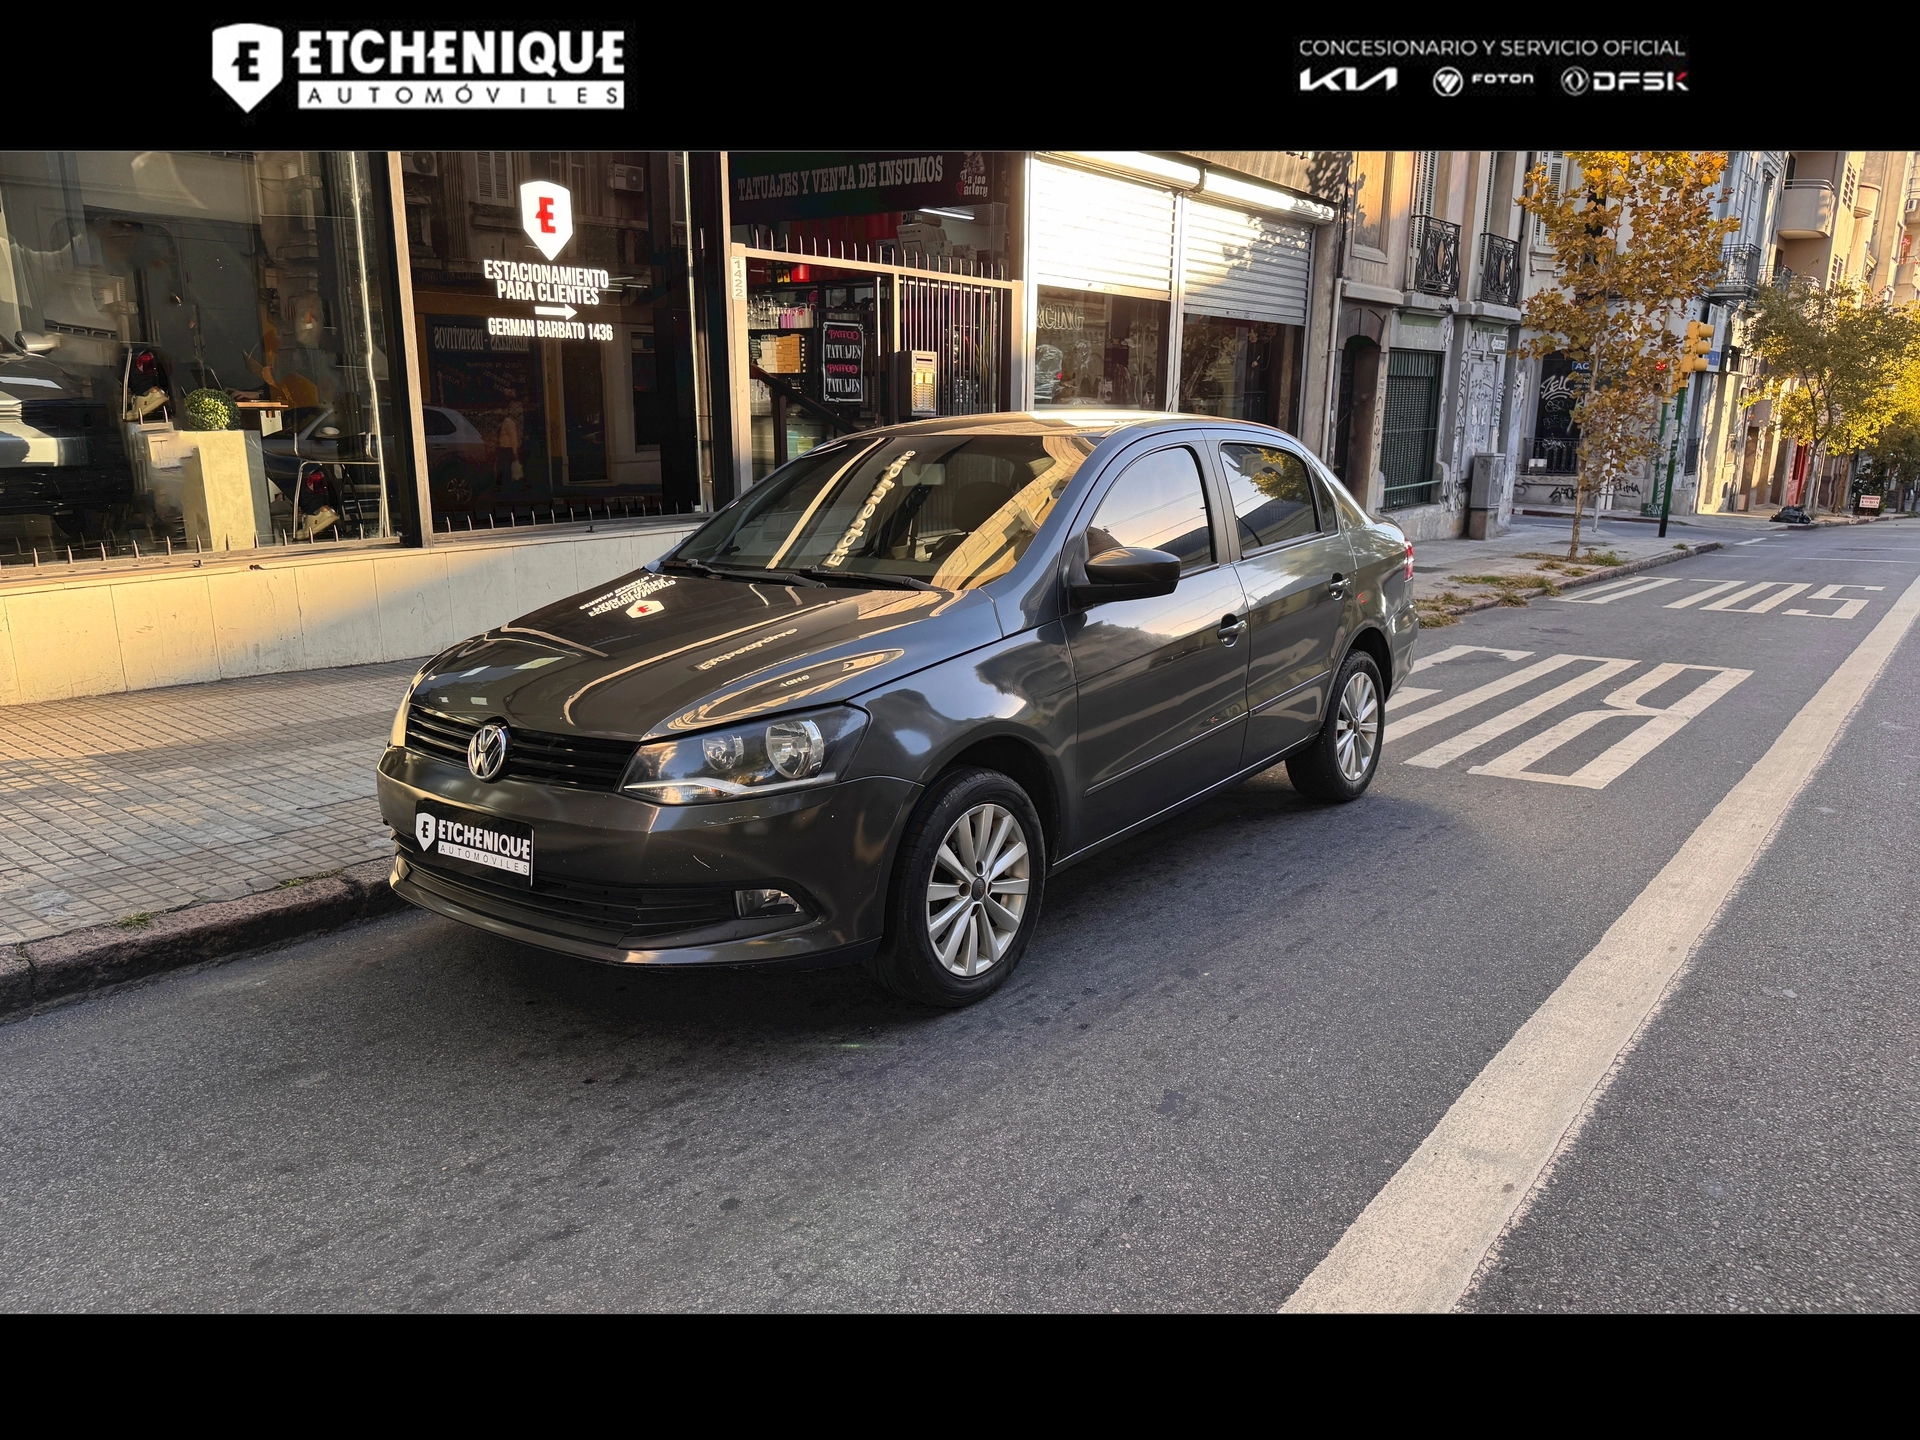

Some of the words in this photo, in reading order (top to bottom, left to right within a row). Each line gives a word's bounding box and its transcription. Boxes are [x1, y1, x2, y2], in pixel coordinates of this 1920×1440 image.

[737, 173, 799, 201] TATUAJES
[800, 170, 810, 195] Y
[812, 167, 856, 192] VENTA
[859, 163, 876, 188] DE
[879, 155, 943, 186] INSUMOS
[483, 259, 609, 288] ESTACIONAMIENTO
[734, 259, 744, 298] 1422
[497, 280, 535, 301] PARA
[537, 283, 600, 306] CLIENTES
[488, 317, 535, 337] GERMAN
[537, 320, 585, 340] BARBATO
[587, 322, 613, 341] 1436
[826, 344, 861, 359] TATUAJES
[826, 378, 860, 393] TATUAJES
[438, 819, 531, 860] ETCHENIQUE
